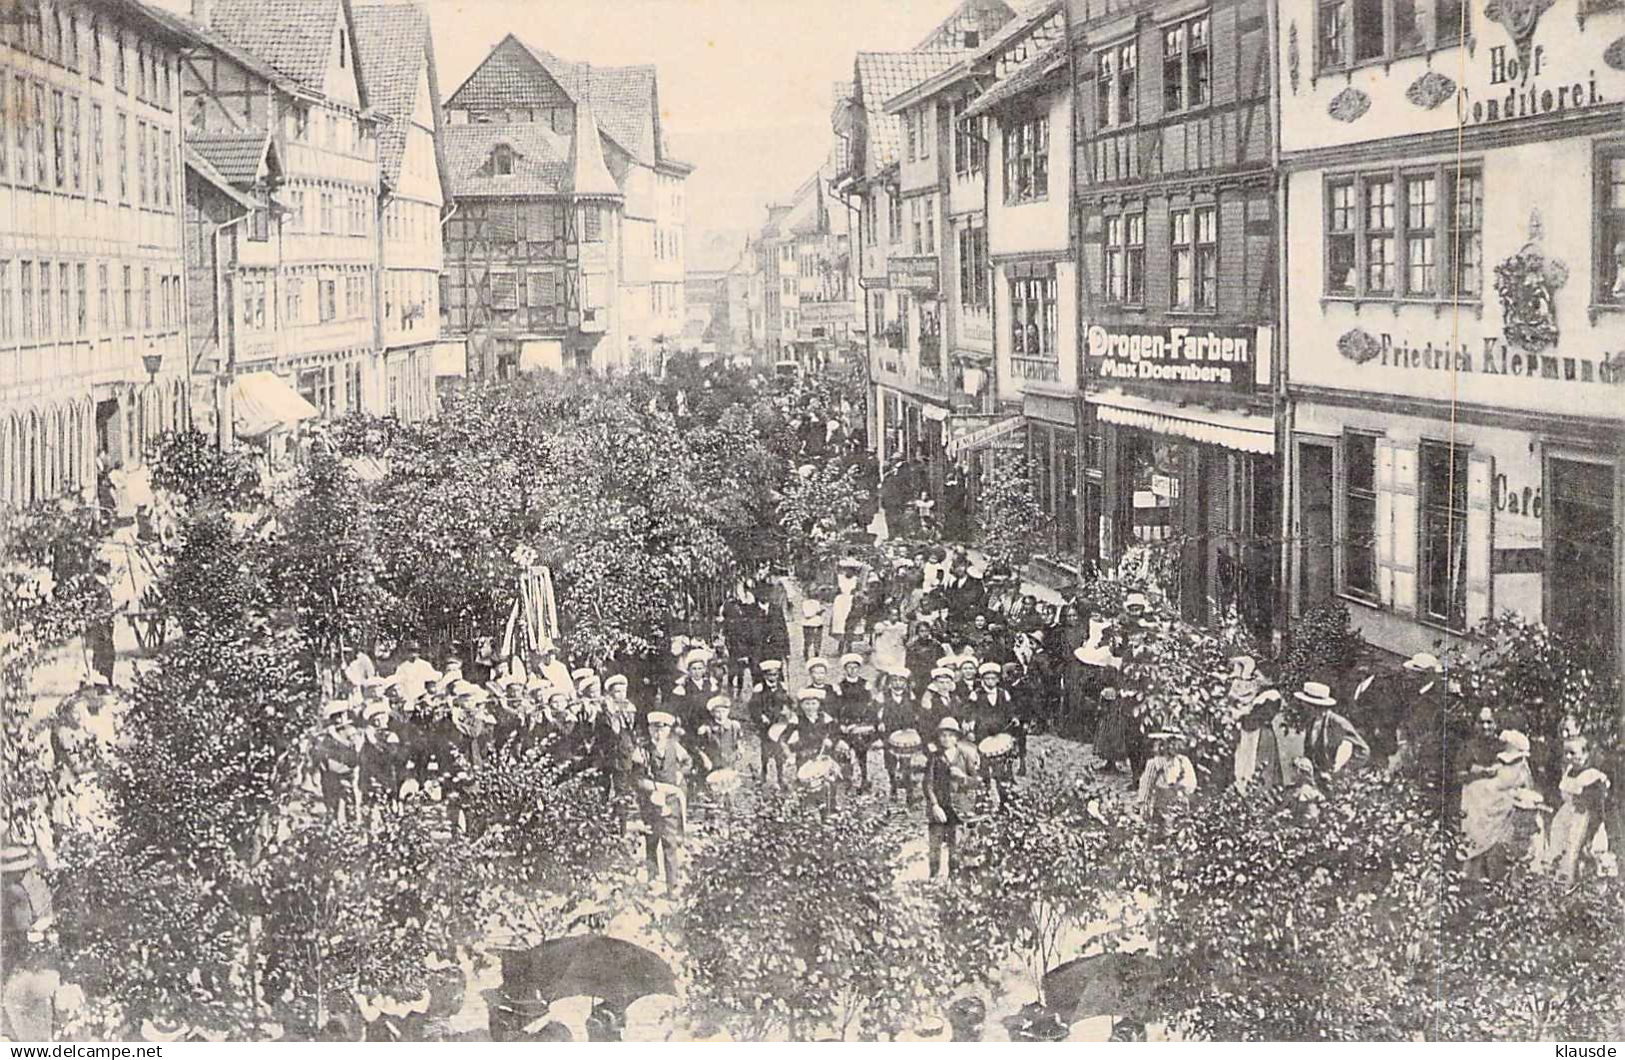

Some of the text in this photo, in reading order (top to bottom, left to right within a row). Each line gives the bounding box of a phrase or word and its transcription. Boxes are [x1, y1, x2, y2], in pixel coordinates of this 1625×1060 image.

[1088, 325, 1248, 363] Drogen-Farben
[1380, 333, 1473, 373] Friedrich
[1101, 359, 1137, 378] Max
[1495, 473, 1542, 518] Café
